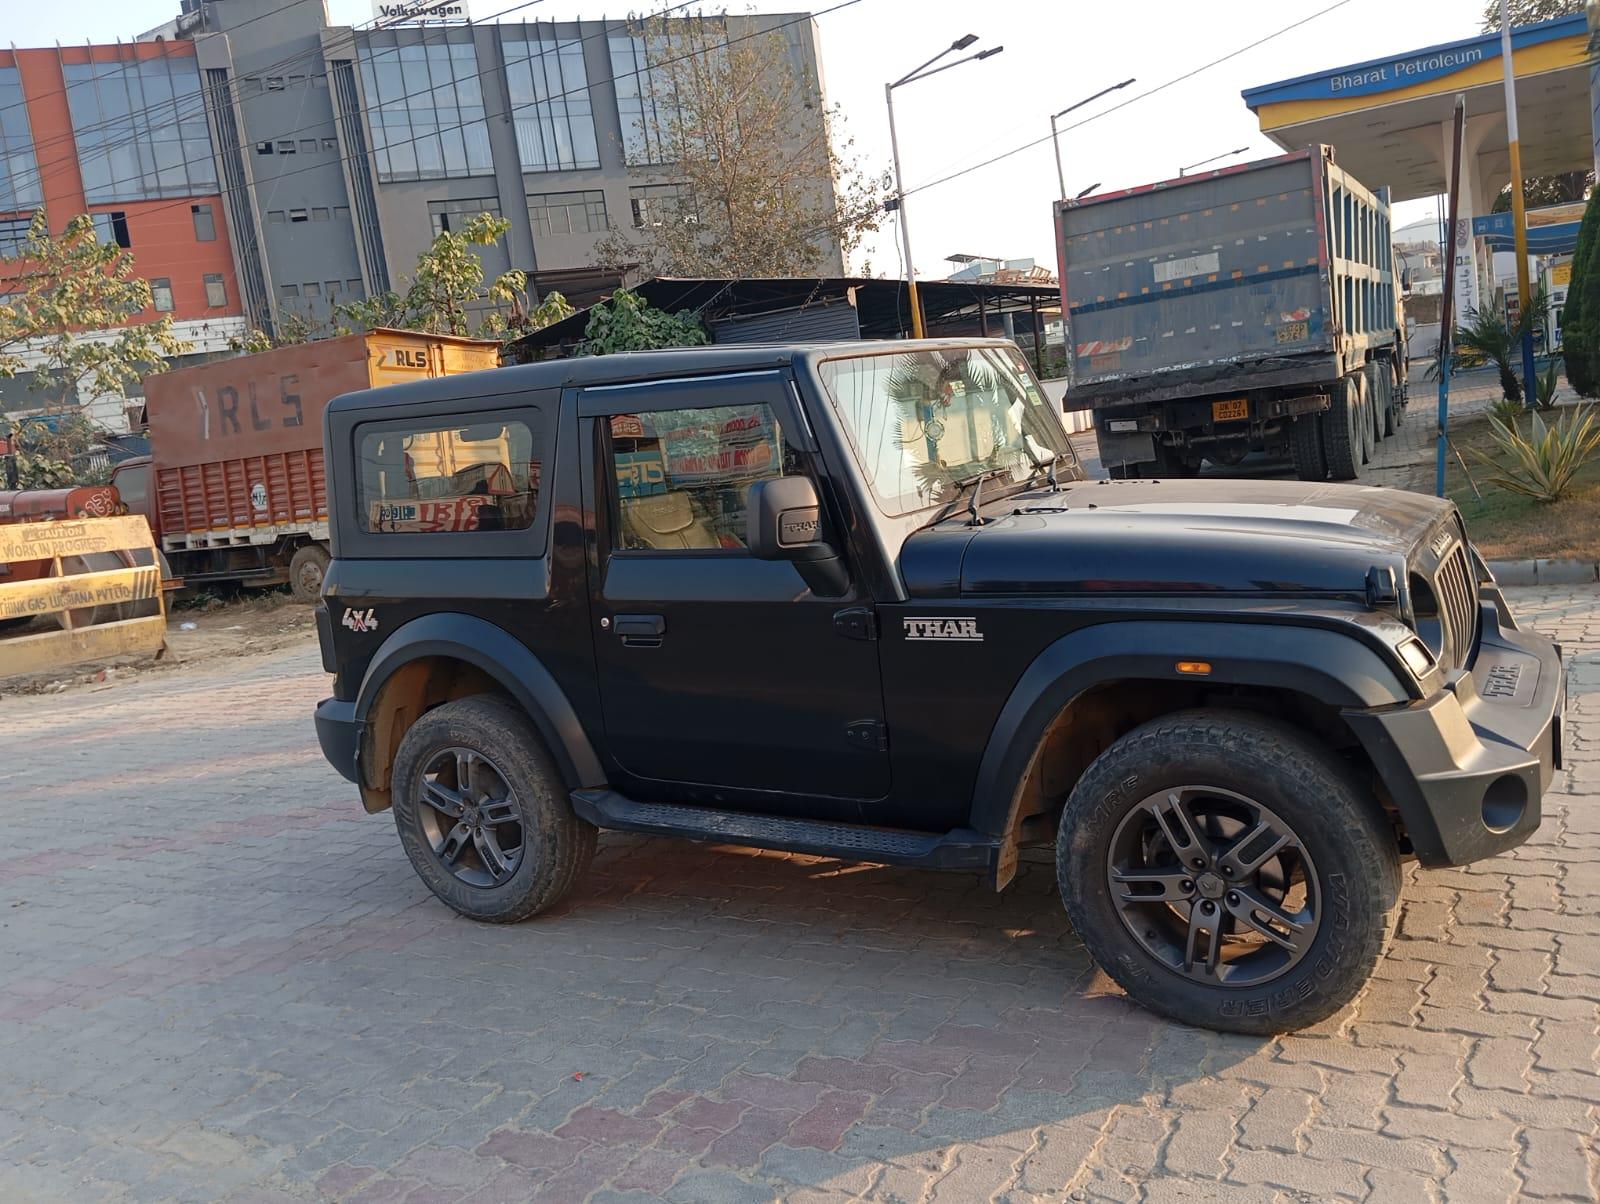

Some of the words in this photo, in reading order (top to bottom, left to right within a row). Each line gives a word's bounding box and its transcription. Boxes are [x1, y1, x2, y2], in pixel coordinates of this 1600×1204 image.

[379, 4, 462, 17] Volkswagen
[1330, 68, 1387, 91] Bharat
[1394, 49, 1482, 77] Petroleum
[396, 349, 427, 368] RLS
[216, 374, 304, 436] RLS
[38, 527, 83, 539] CAUTION
[2, 543, 37, 558] WORK
[38, 541, 51, 555] IN
[53, 537, 107, 554] PROGRESS
[28, 597, 47, 611] GAS
[903, 618, 984, 640] THAR
